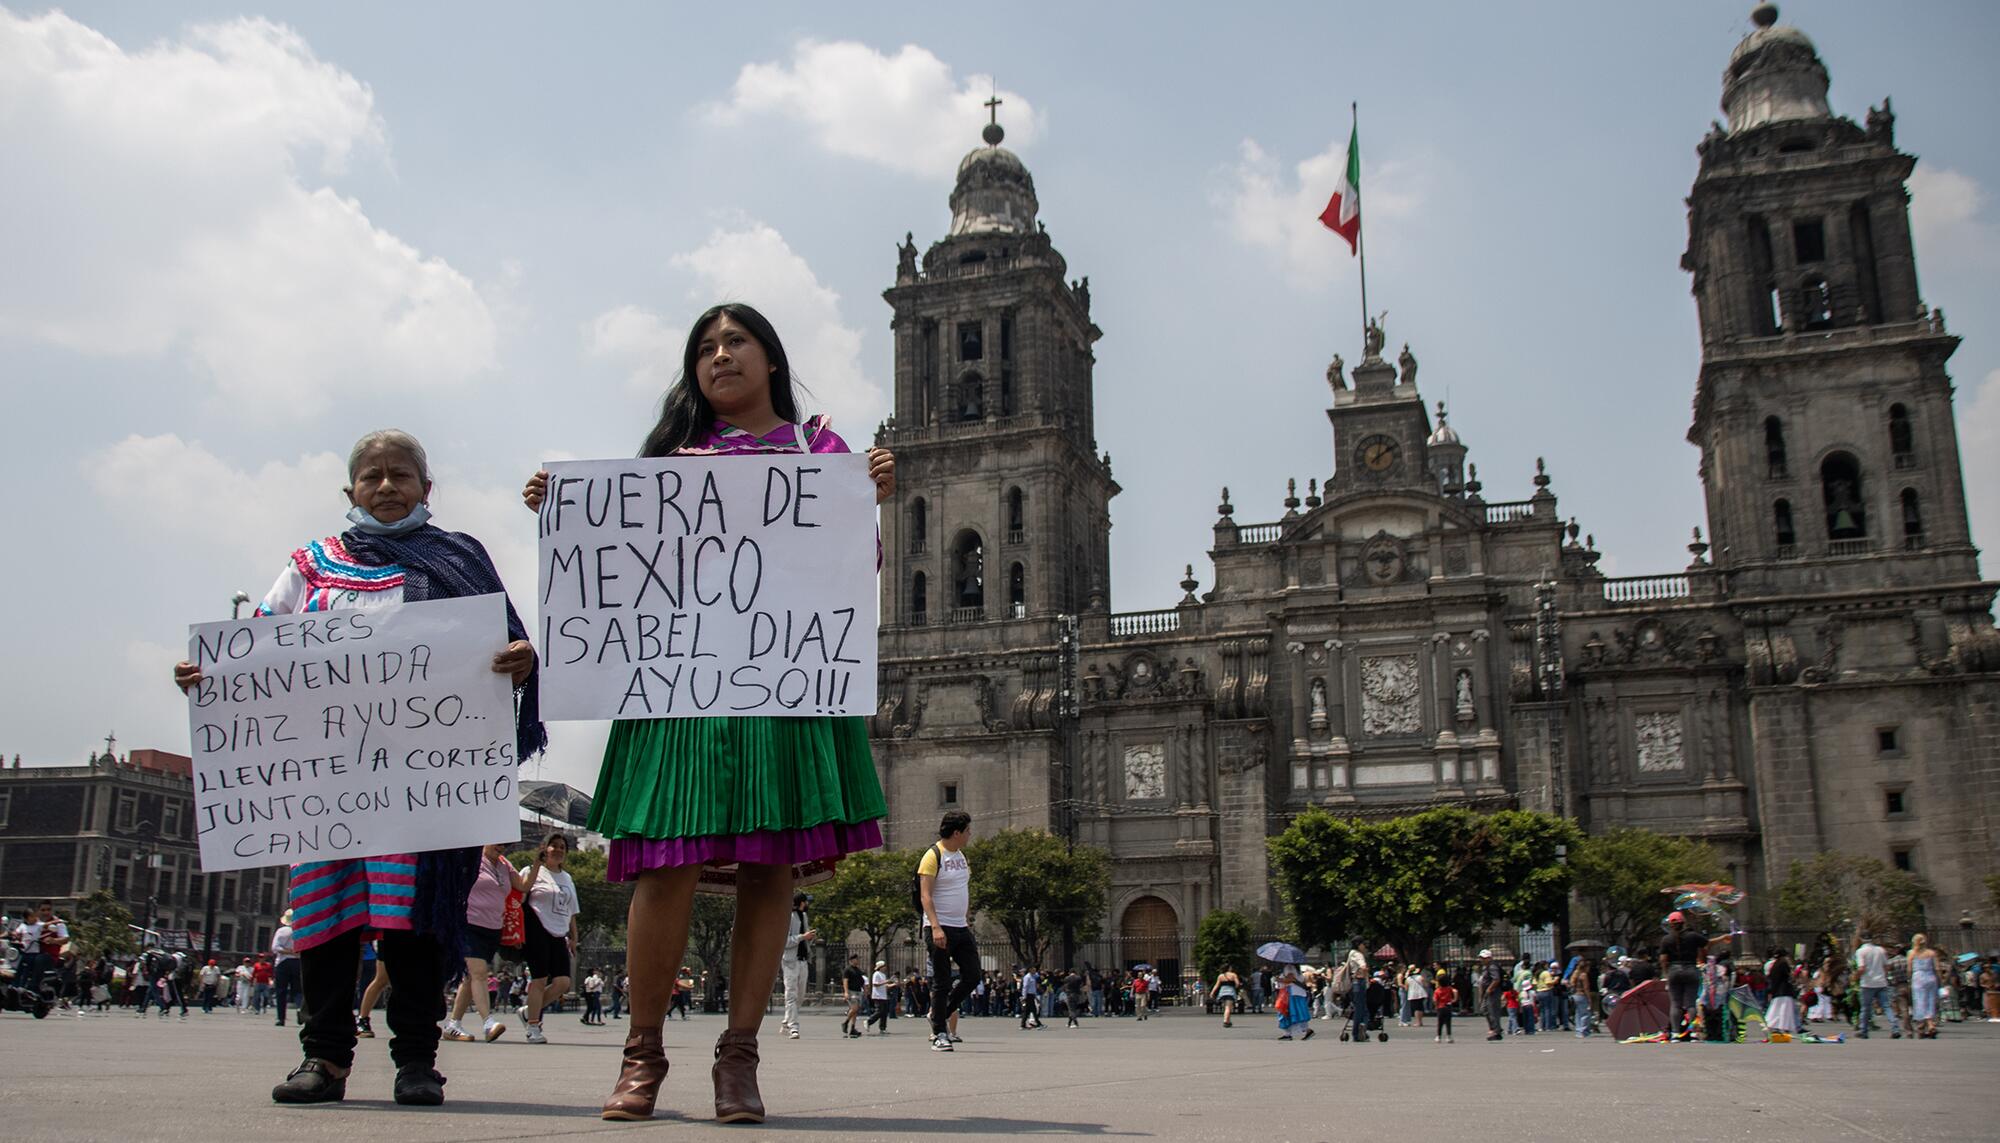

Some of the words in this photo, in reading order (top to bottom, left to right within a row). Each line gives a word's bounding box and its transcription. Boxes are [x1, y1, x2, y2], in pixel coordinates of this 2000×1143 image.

[763, 466, 822, 528] DE
[544, 535, 762, 614] MEXICO
[198, 627, 255, 671] NO
[273, 613, 374, 648] ERES
[545, 612, 718, 668] ISABEL
[749, 607, 861, 665] DIAZ
[195, 644, 432, 708] BIENVENIDA
[618, 664, 850, 715] AYUSO!!!
[195, 713, 299, 753] DÍAZ
[321, 694, 487, 765] AYUSO...
[199, 754, 348, 793] LLEVATE
[372, 747, 390, 772] A
[405, 740, 514, 771] CORTÉS
[406, 775, 512, 812] NACHO
[233, 822, 362, 858] CANO.
